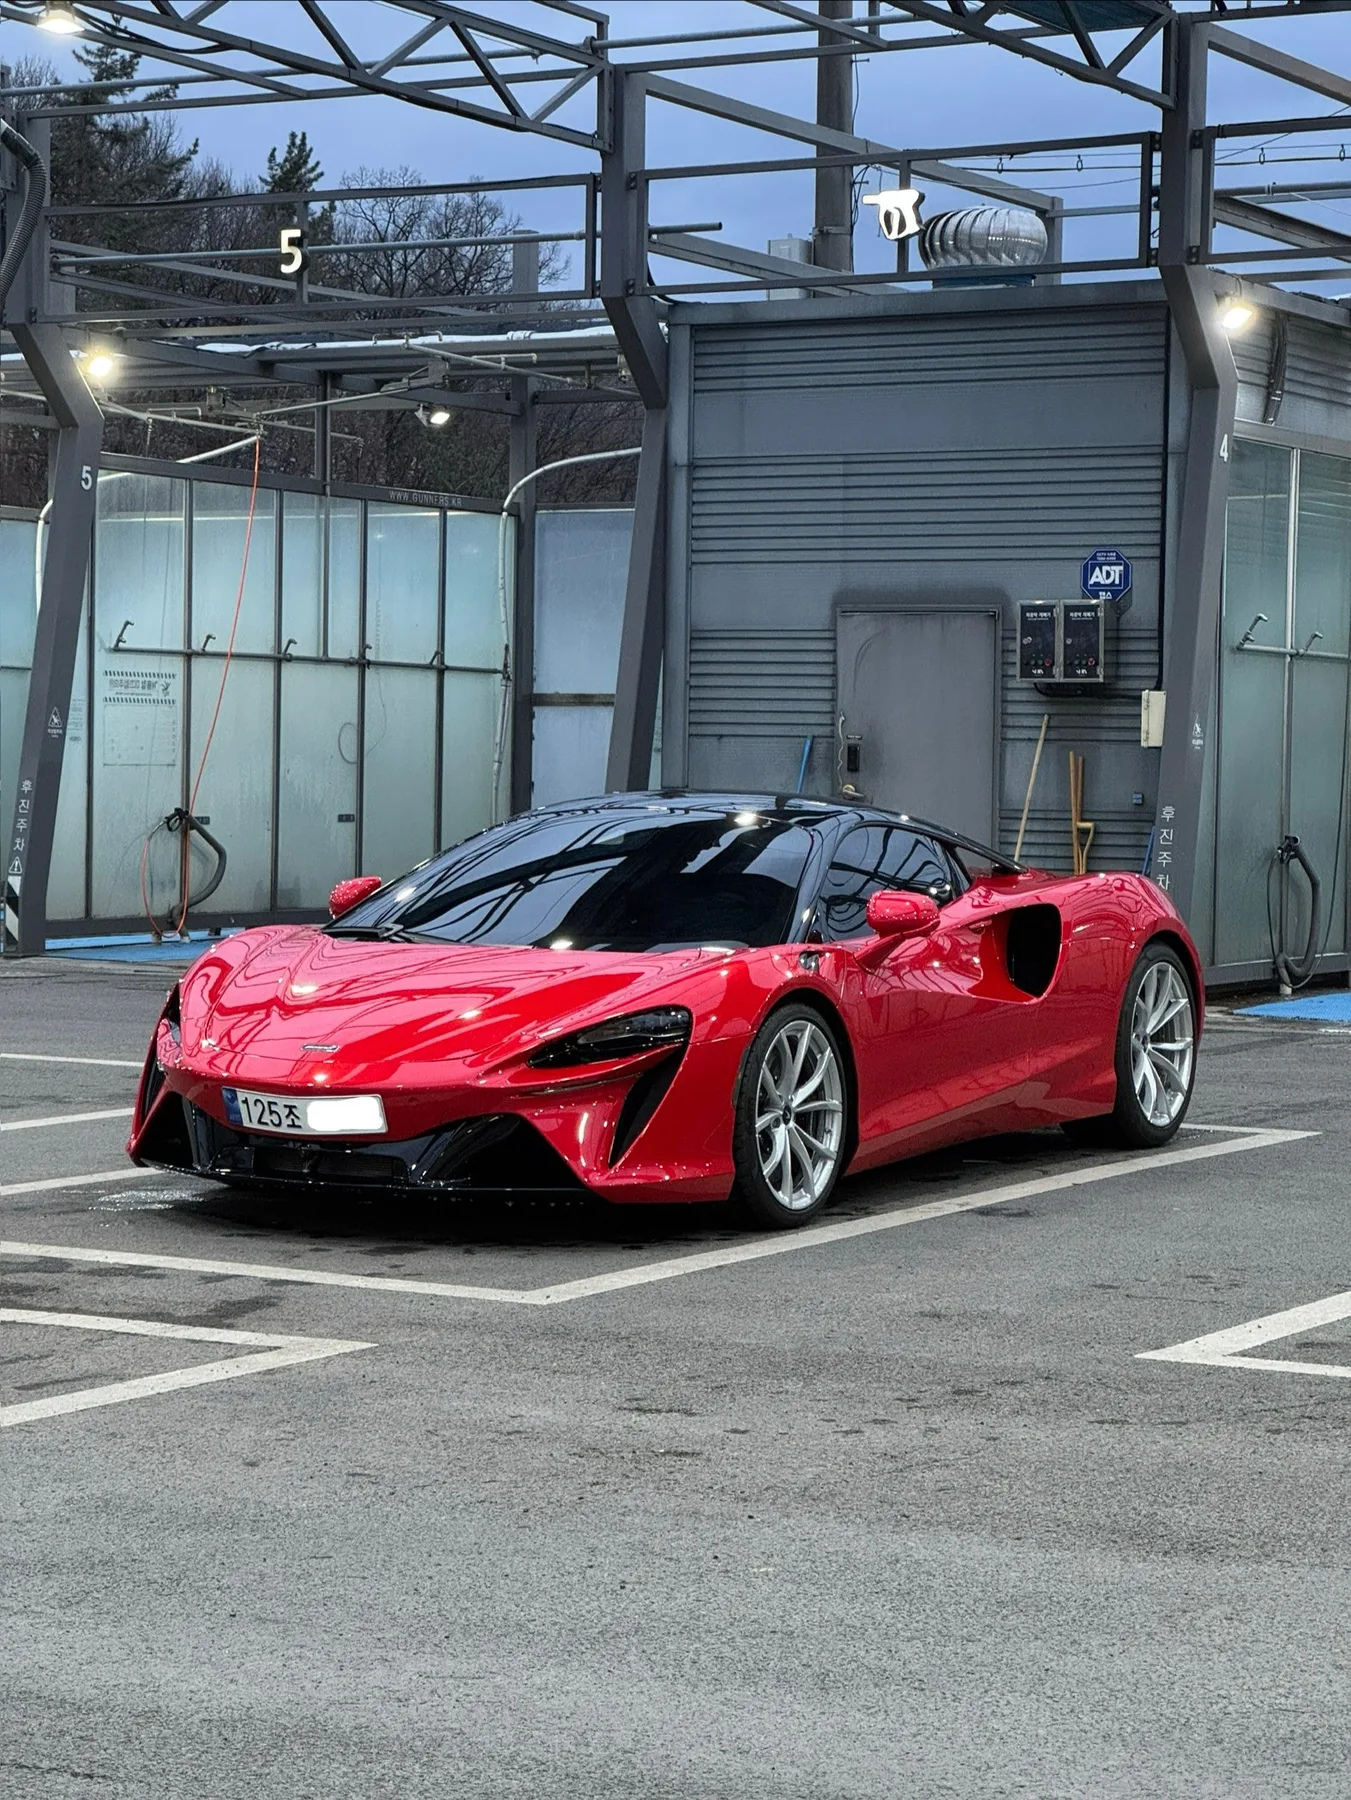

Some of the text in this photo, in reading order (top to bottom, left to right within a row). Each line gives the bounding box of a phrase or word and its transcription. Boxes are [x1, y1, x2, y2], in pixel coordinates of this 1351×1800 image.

[281, 229, 302, 274] 5
[1219, 433, 1229, 462] 4
[81, 465, 92, 490] 5
[388, 490, 463, 507] WWW.GUNNERS.KR
[1088, 565, 1124, 585] ADT
[13, 779, 33, 852] 후진주차
[1156, 806, 1176, 891] 후진주차
[241, 1096, 303, 1130] 125조
